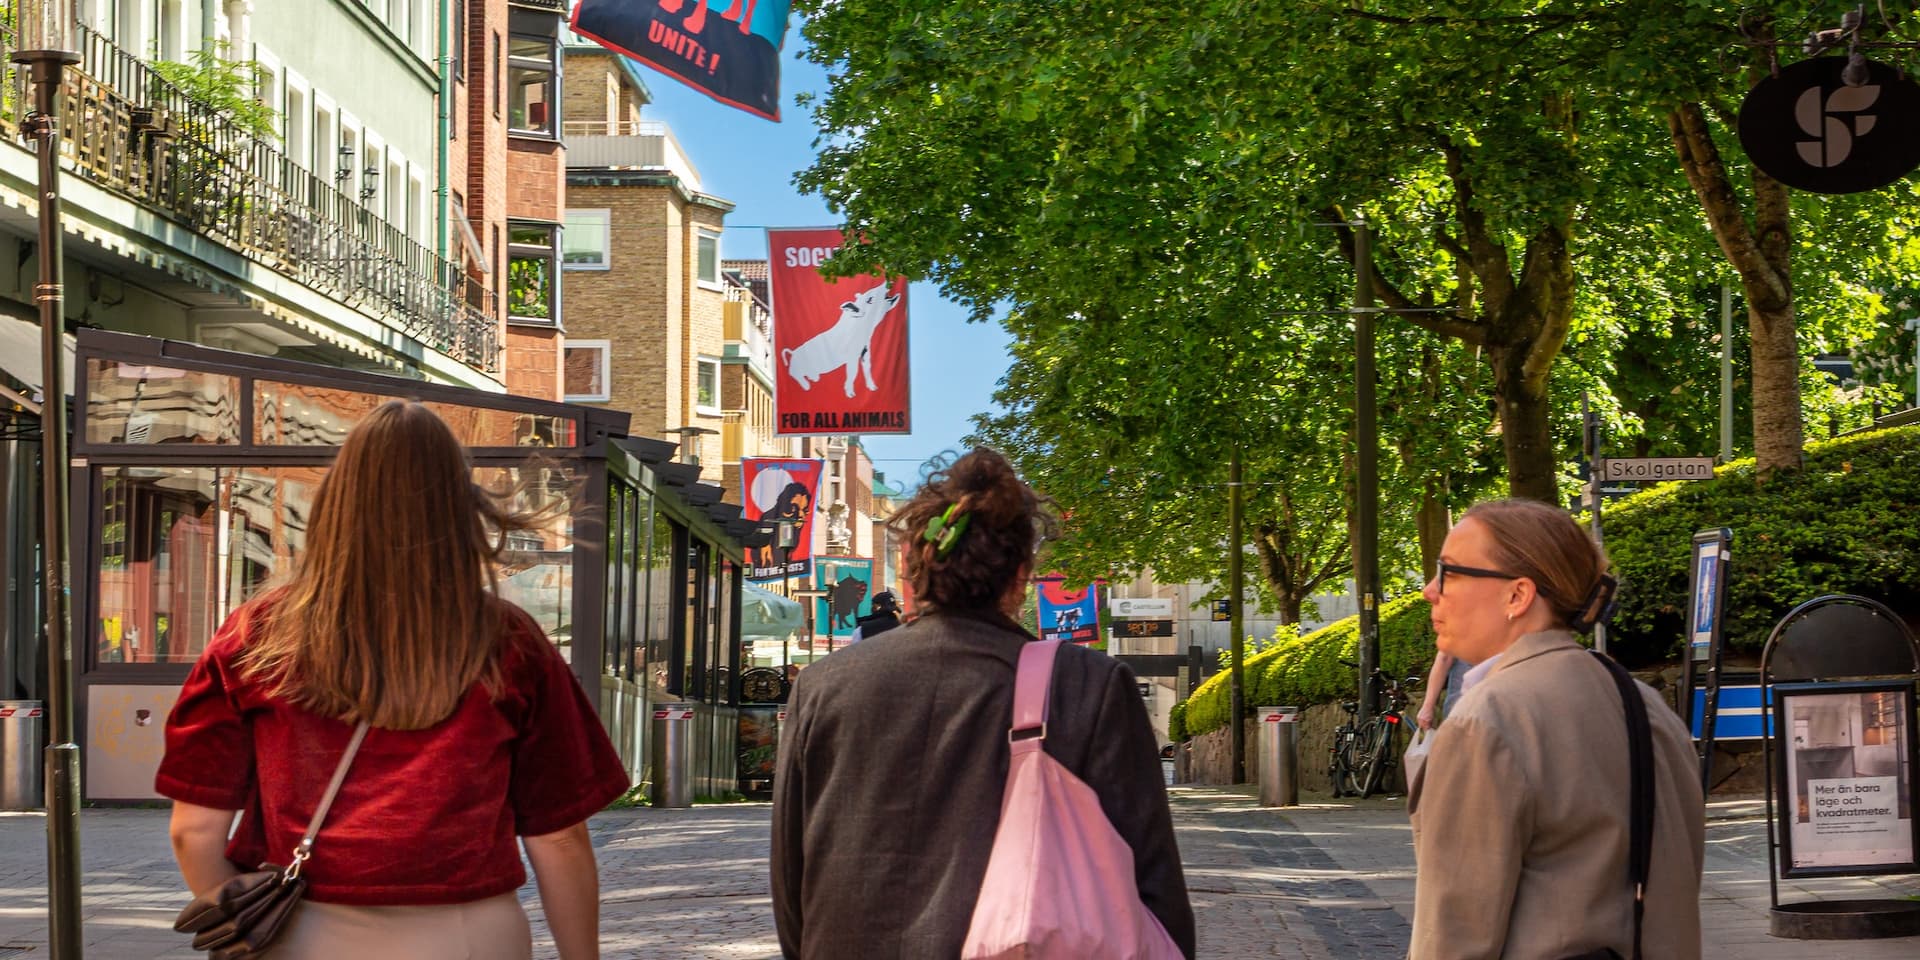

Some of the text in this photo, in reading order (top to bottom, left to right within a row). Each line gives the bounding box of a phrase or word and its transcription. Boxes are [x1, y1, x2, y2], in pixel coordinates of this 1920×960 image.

[648, 19, 707, 68] UNITE
[782, 411, 905, 429] FOR ALL ANIMALS
[1612, 462, 1707, 478] Skolgatan
[1815, 783, 1881, 795] Mer än bara
[1815, 795, 1863, 808] läge och
[1815, 807, 1892, 818] kvadratmeter.
